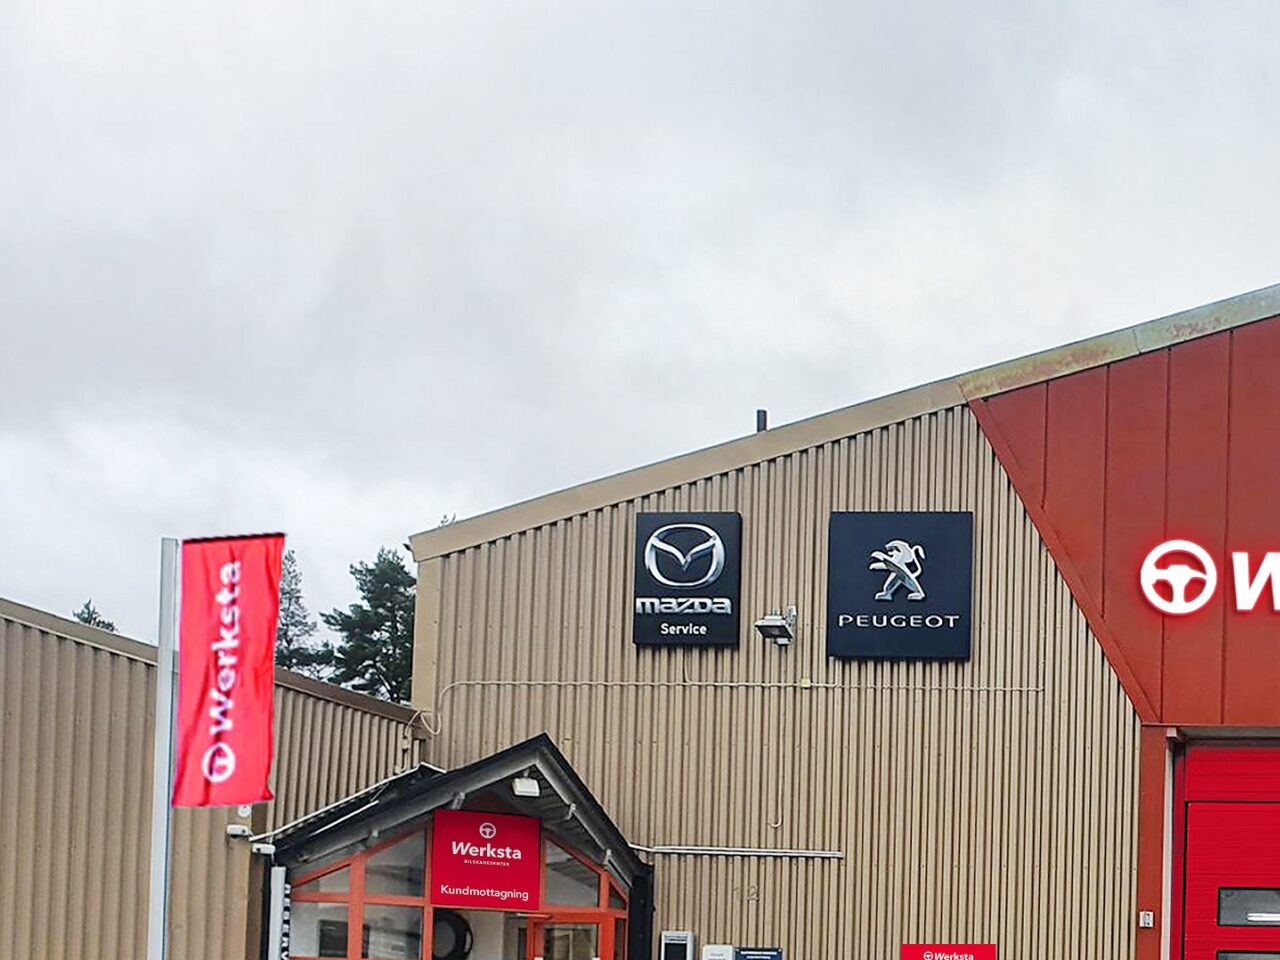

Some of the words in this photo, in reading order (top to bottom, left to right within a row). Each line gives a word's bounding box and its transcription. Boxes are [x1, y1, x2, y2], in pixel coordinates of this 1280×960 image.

[635, 597, 732, 614] mazda
[660, 622, 707, 635] Service
[838, 614, 960, 628] PEUGEOT
[209, 560, 242, 735] Werksta
[451, 841, 522, 860] Werksta
[440, 884, 529, 902] Kundmottagning
[934, 952, 974, 960] Werksta
